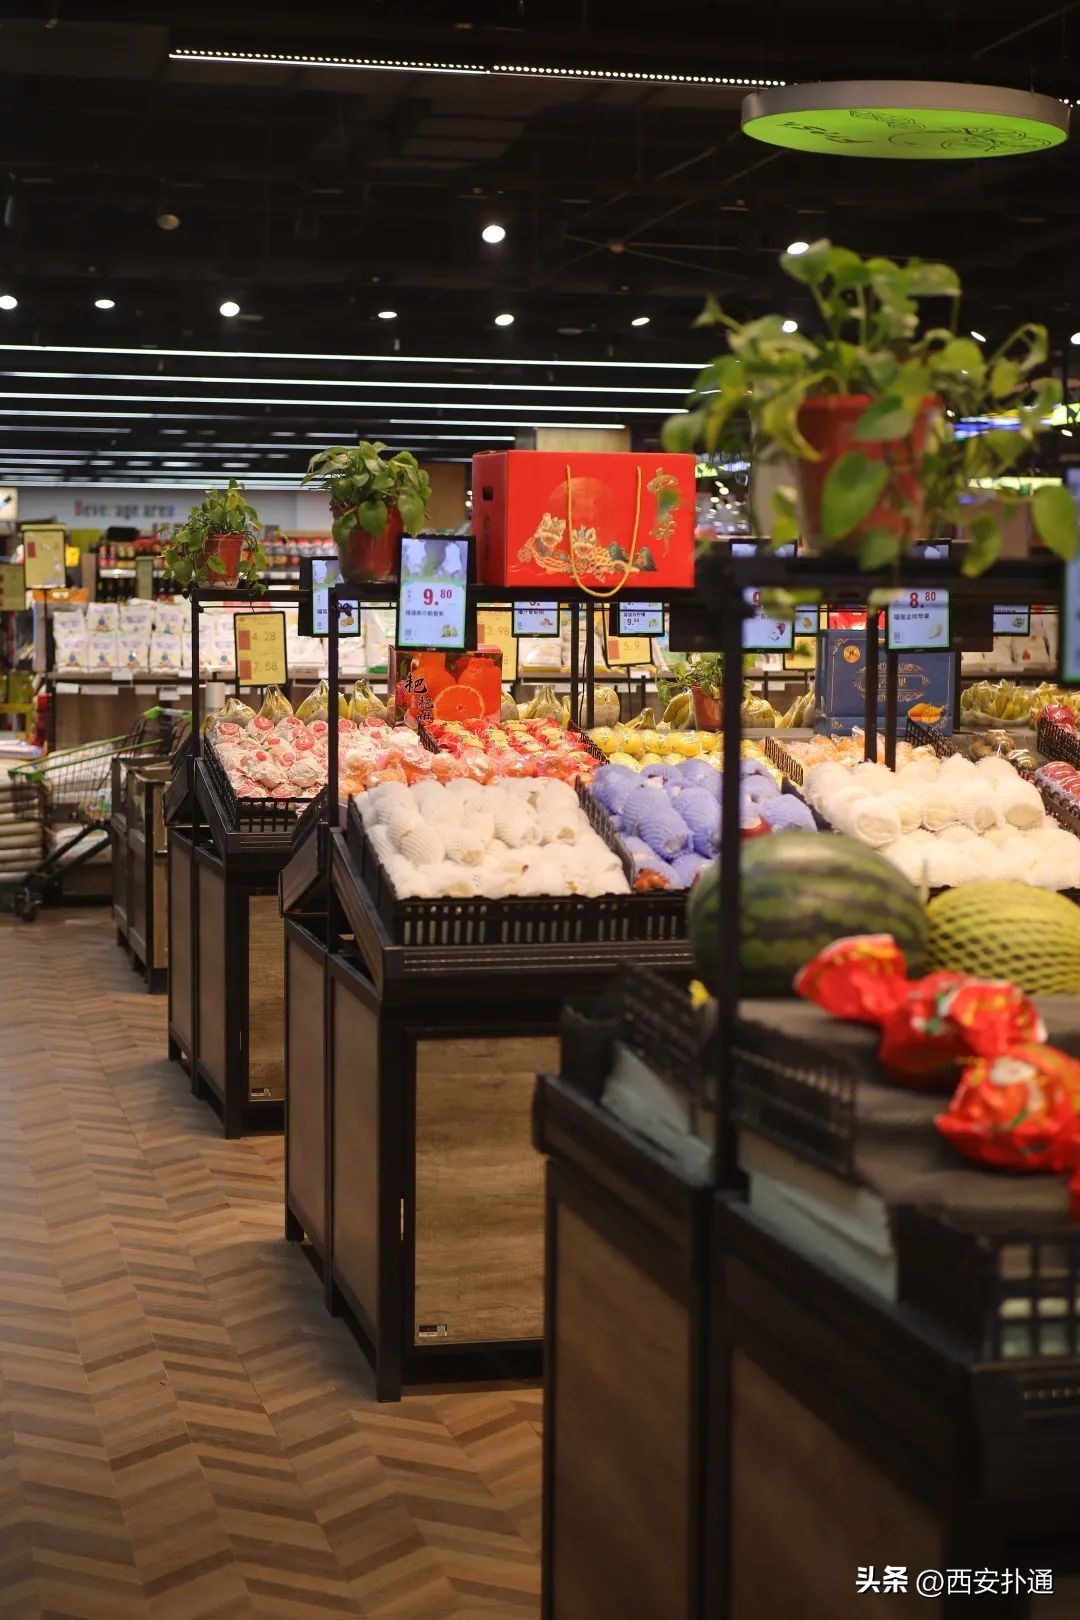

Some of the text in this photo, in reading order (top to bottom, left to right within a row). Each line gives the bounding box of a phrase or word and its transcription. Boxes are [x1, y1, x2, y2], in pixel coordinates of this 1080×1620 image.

[74, 499, 175, 520] Beverage area
[423, 588, 452, 606] 9.80
[909, 591, 936, 609] 8.80
